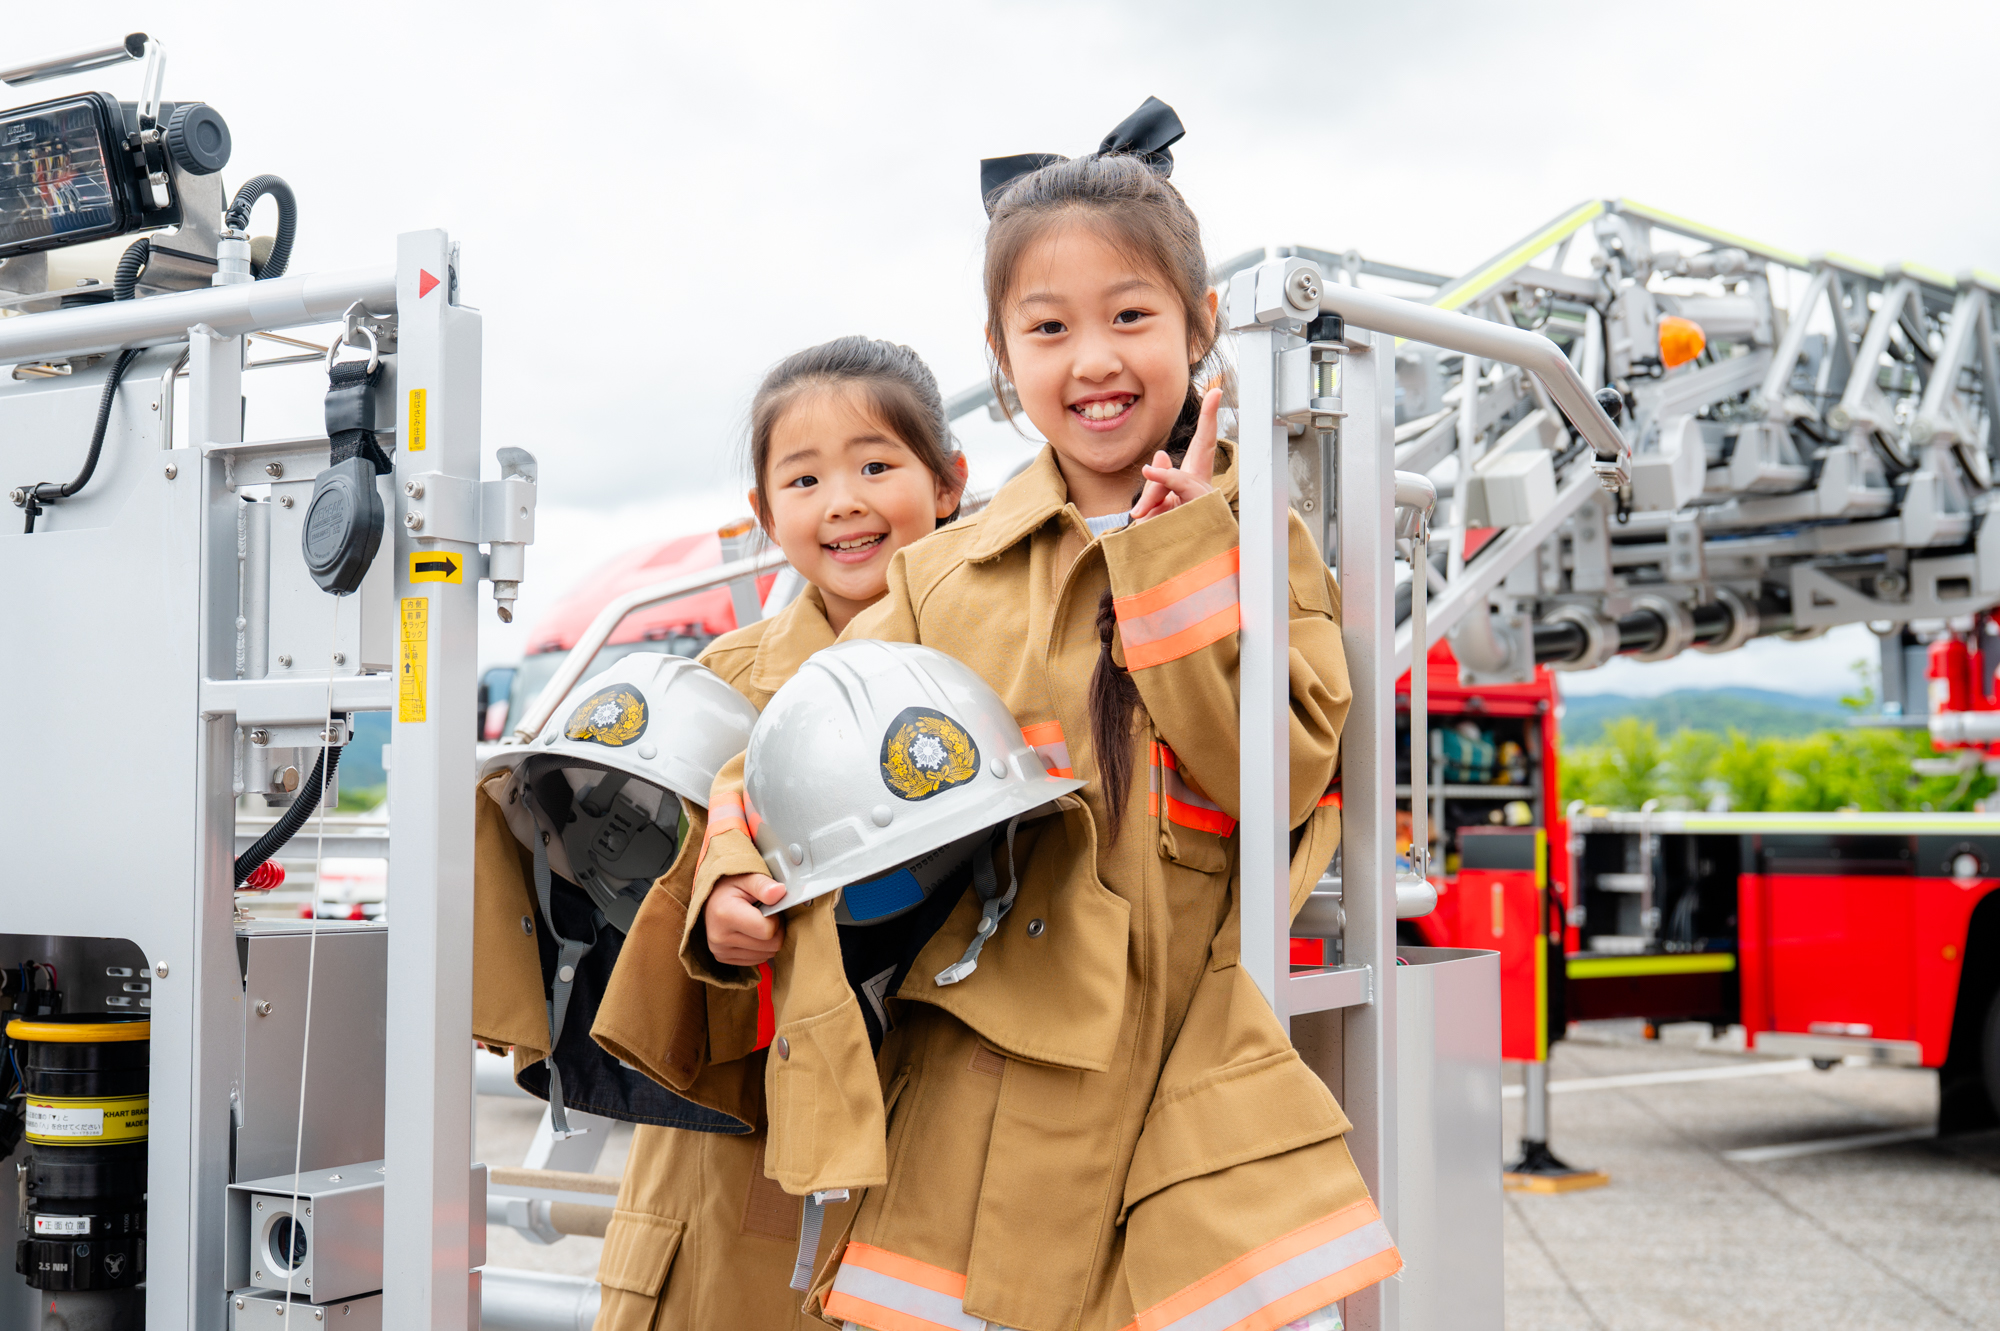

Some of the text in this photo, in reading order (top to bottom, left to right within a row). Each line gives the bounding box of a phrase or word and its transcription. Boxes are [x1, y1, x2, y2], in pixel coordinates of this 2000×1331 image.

[413, 391, 421, 445] 指はさみ注意
[407, 600, 421, 608] 内側
[403, 621, 426, 629] タラップ
[404, 652, 418, 660] 解除
[125, 1120, 143, 1128] MADE
[45, 1221, 86, 1230] 正面位置
[38, 1262, 68, 1271] 2.5 NH
